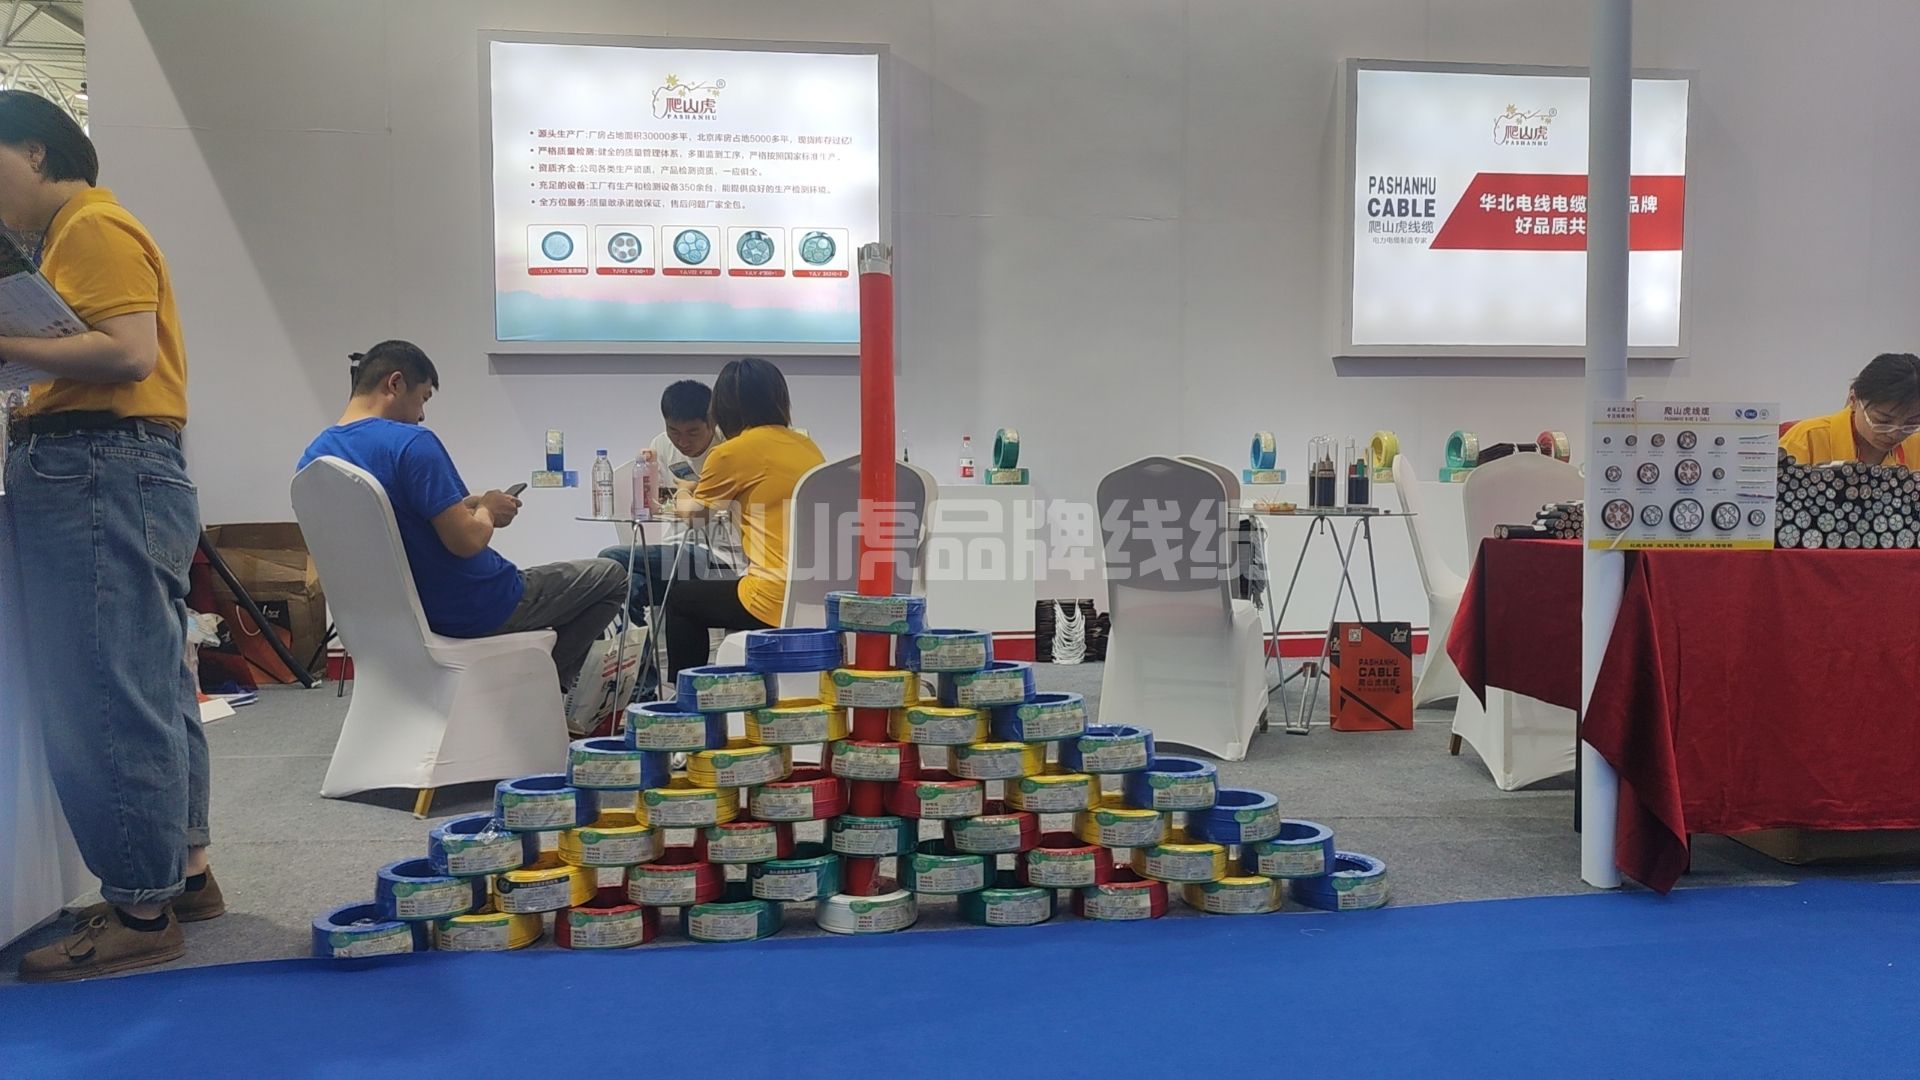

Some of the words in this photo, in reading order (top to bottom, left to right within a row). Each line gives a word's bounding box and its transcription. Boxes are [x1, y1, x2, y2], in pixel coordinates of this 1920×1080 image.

[666, 97, 717, 114] 爬山虎
[1505, 125, 1548, 140] 爬山虎
[1368, 175, 1437, 195] PASHANHU
[1367, 197, 1436, 218] CABLE
[1368, 220, 1435, 234] 爬山虎线缆
[1515, 216, 1587, 235] 好品质共
[1358, 667, 1400, 677] CABLE
